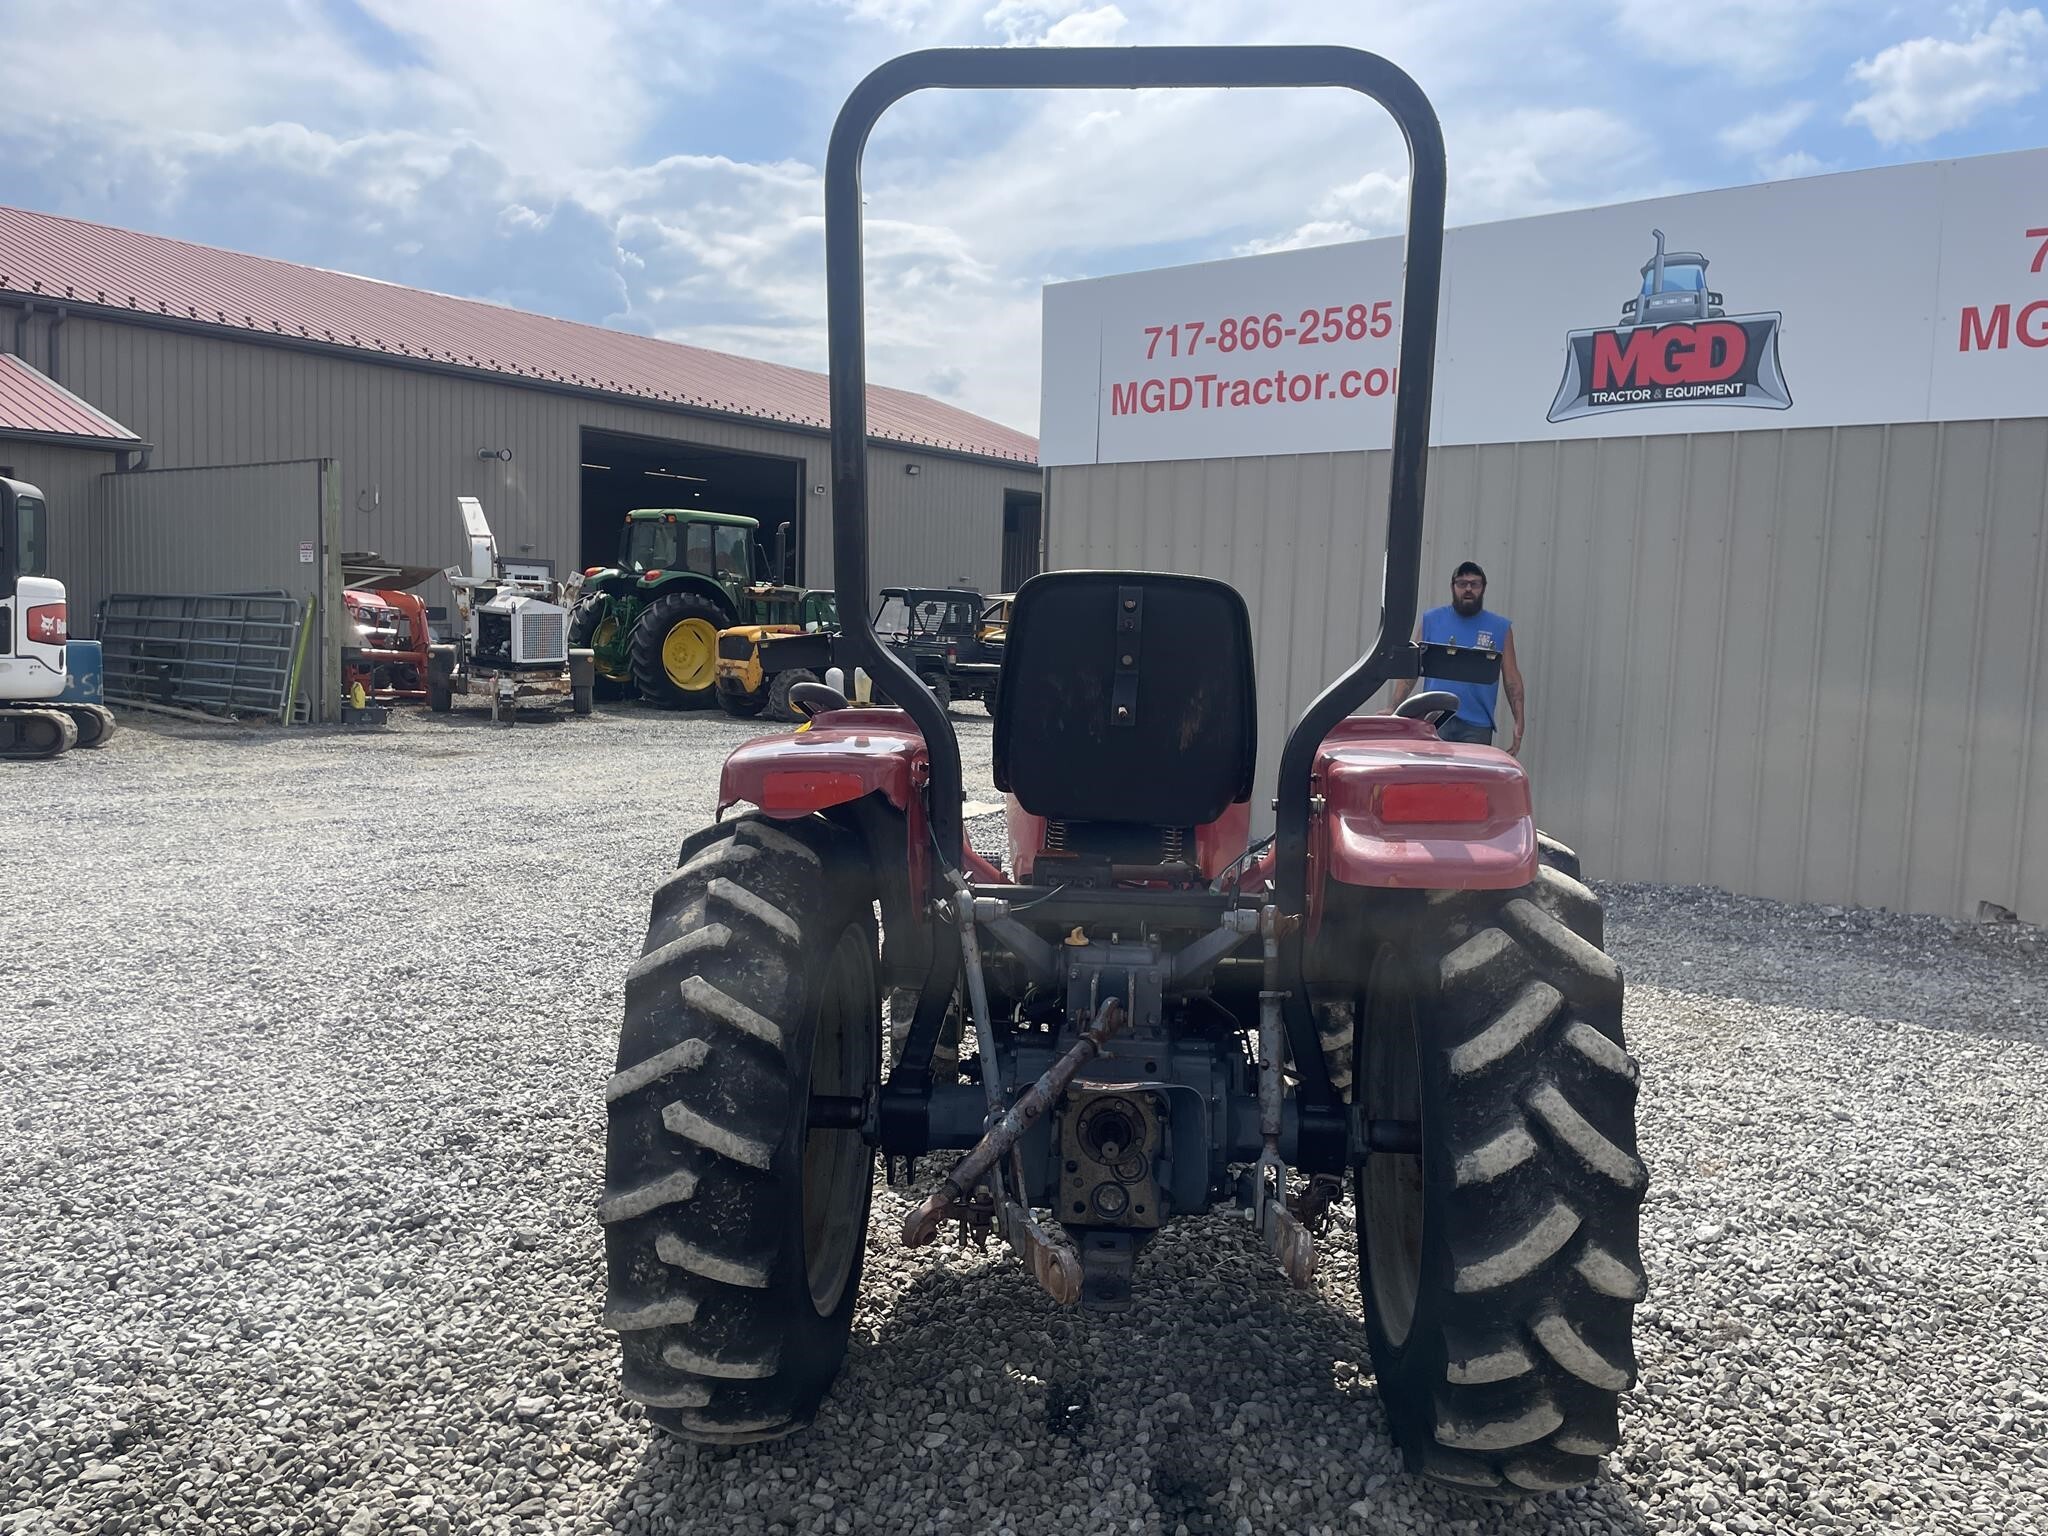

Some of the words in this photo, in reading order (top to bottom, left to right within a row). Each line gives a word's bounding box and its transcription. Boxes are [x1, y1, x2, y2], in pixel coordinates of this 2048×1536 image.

[1144, 301, 1393, 360] 717-866-2585
[1592, 322, 1747, 389] MGD
[1111, 367, 1398, 416] MGDTractor.co
[1592, 389, 1651, 403] TRACTOR
[1653, 388, 1663, 399] &
[1665, 382, 1744, 399] EQUIPMENT
